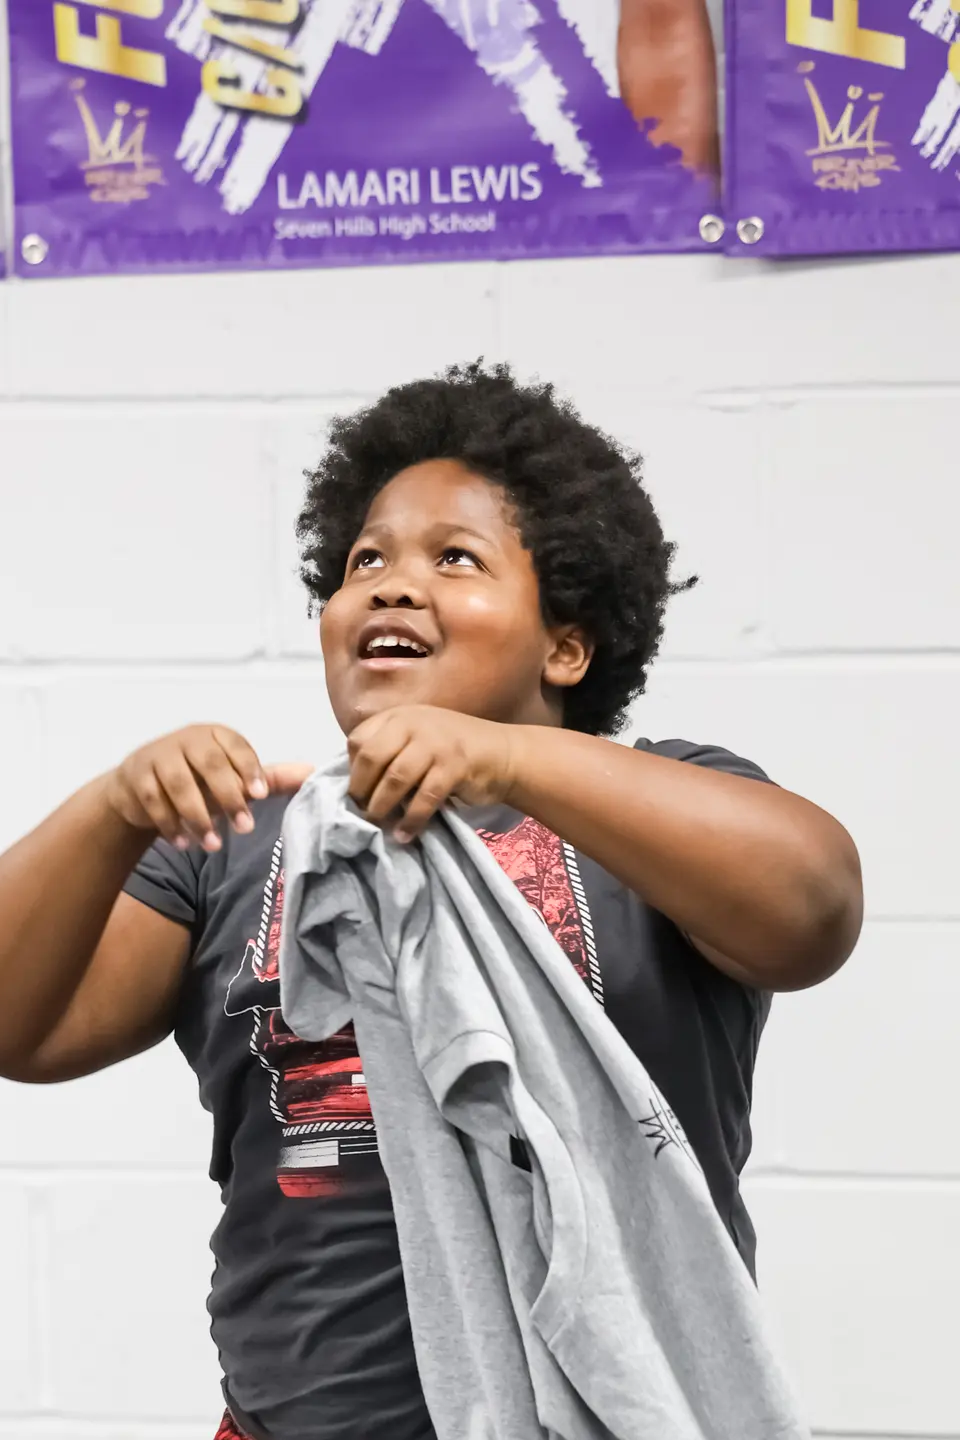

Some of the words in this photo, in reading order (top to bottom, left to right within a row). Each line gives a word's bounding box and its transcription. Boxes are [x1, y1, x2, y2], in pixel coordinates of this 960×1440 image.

[53, 0, 167, 87] F
[277, 167, 421, 209] LAMARI
[430, 162, 543, 204] LEWIS
[274, 216, 333, 240] Seven
[334, 215, 377, 238] Hills
[379, 212, 427, 240] High
[428, 209, 496, 236] School
